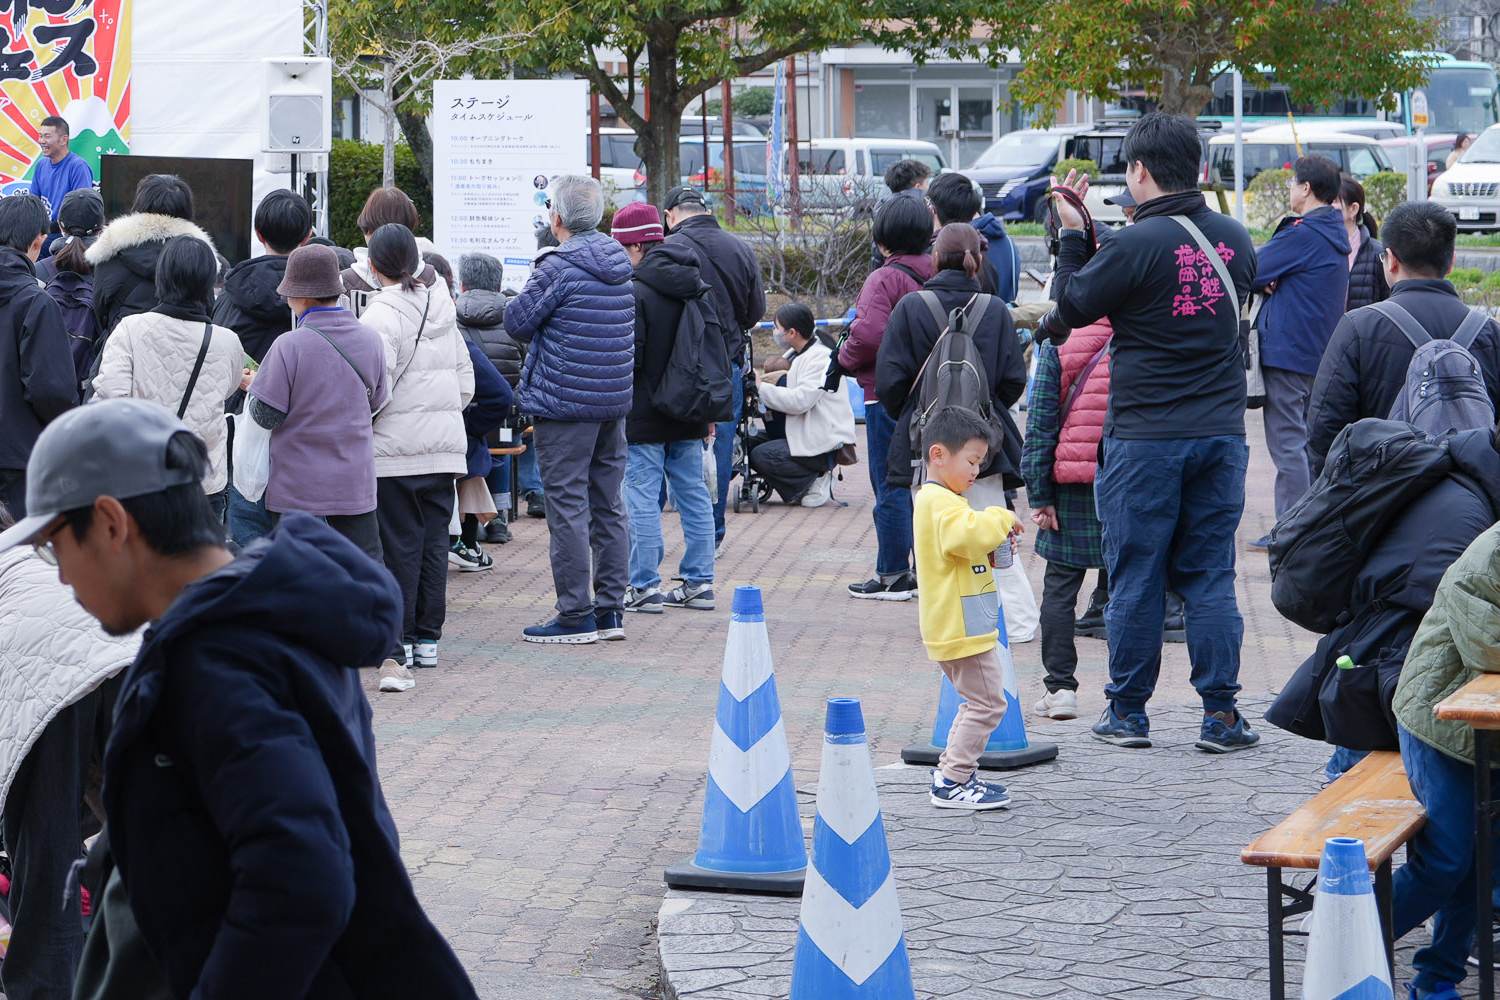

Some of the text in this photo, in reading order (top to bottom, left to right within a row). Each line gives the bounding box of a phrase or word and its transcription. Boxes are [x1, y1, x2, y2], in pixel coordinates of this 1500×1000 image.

[450, 94, 511, 109] ステージ
[450, 113, 533, 121] タイムスケジュール
[1172, 244, 1202, 317] 福岡の海
